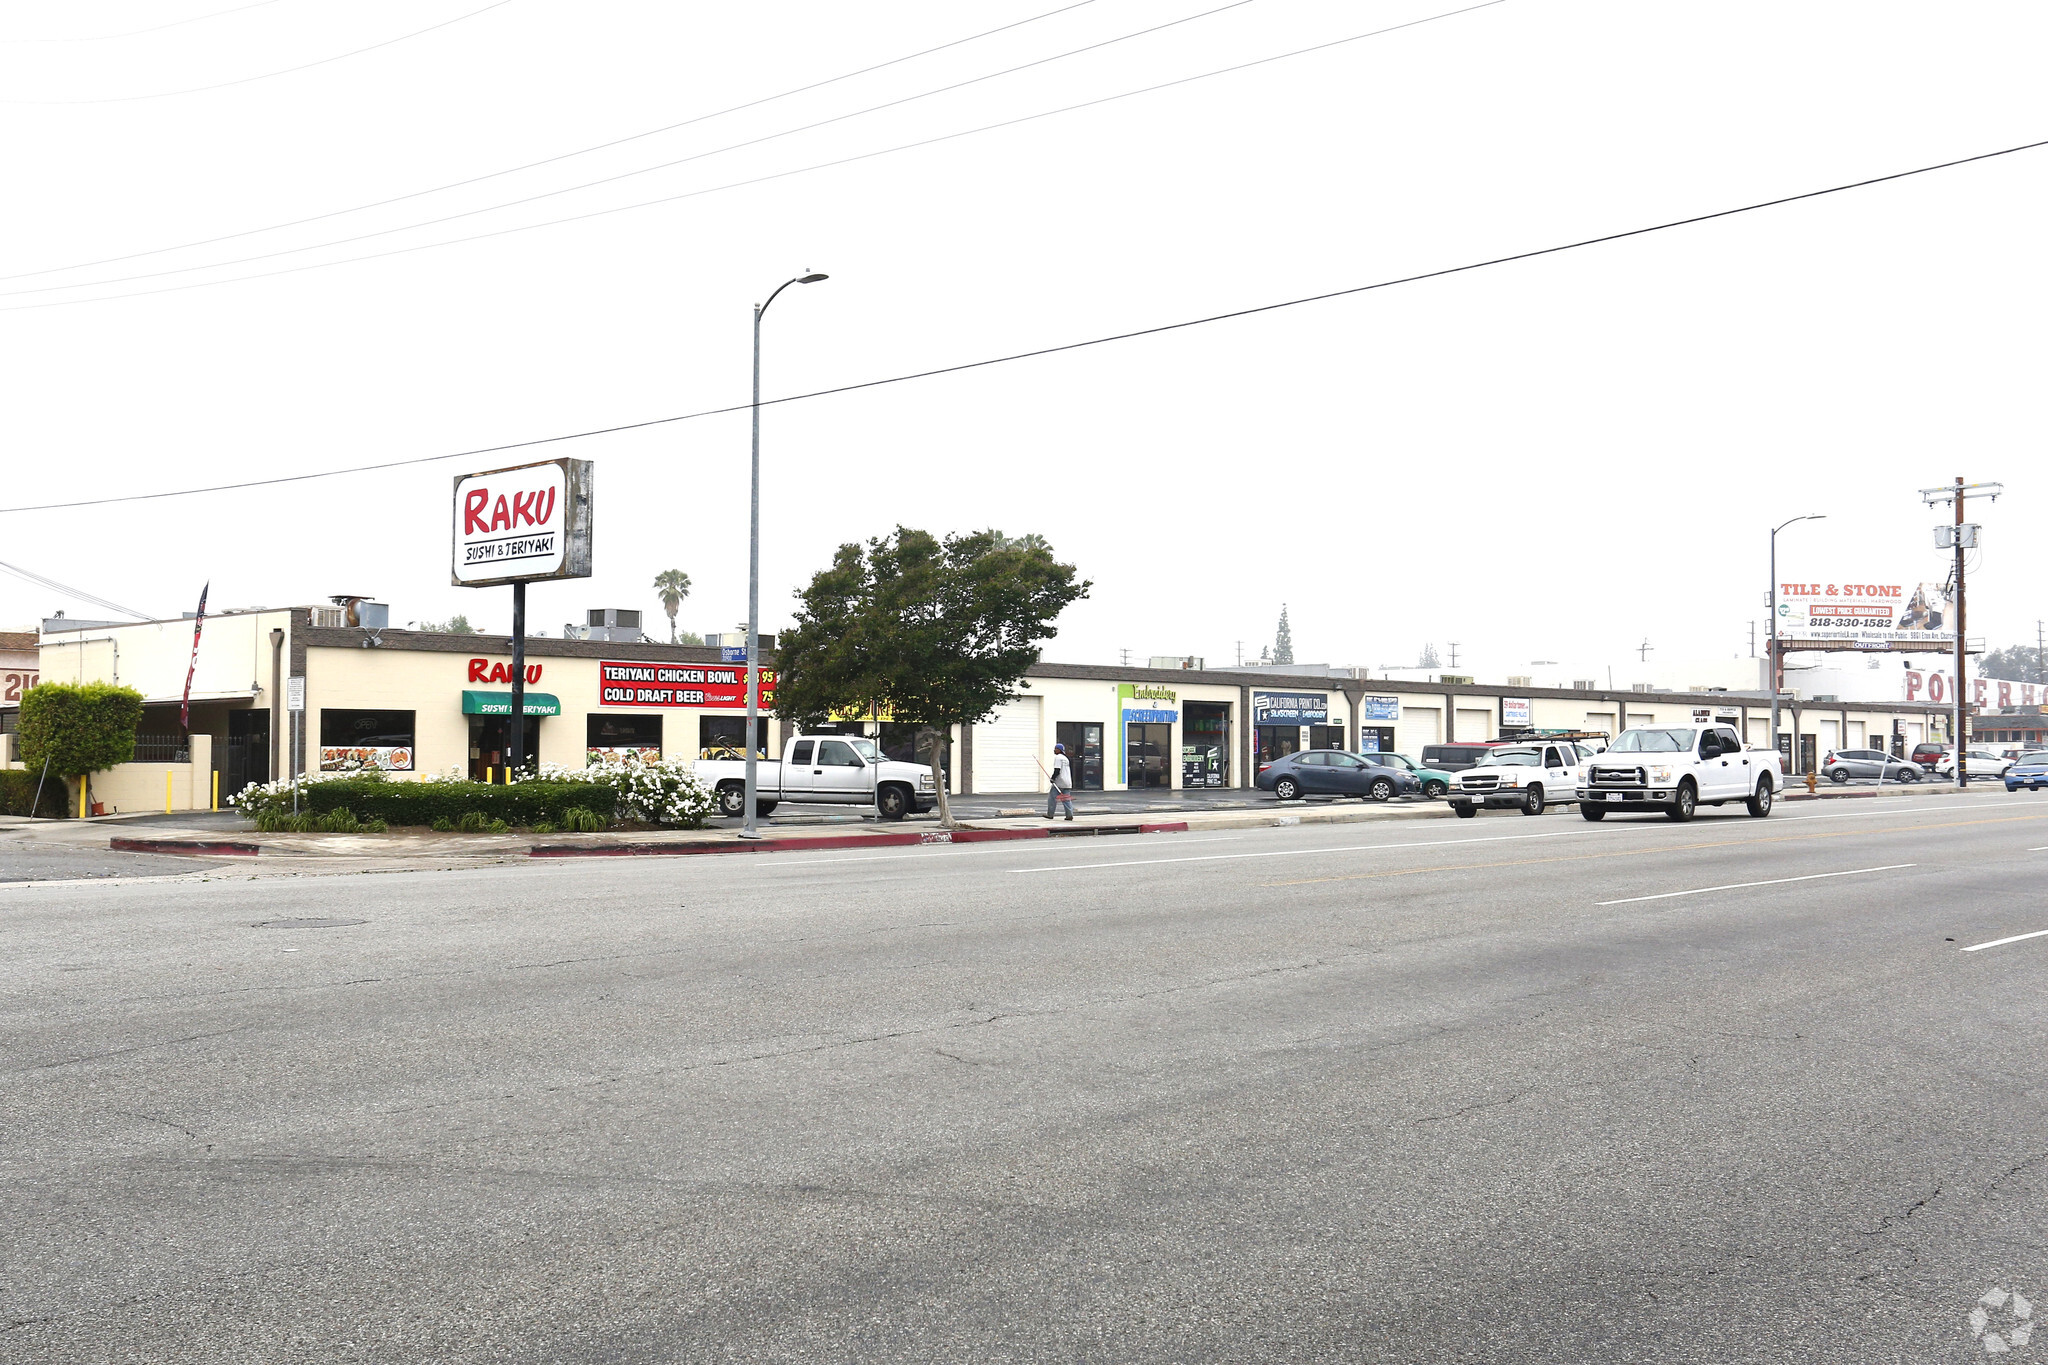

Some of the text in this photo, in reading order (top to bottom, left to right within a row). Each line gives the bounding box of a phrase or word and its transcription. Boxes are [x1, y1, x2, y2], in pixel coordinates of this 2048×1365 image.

[464, 486, 555, 535] RAKU
[466, 537, 554, 560] SUSHI & TERIYAKI
[1780, 584, 1901, 597] TILE & STONE
[1812, 607, 1890, 616] LOWEST PRICE GUARANTEED
[1809, 618, 1892, 628] 818-330-1582
[722, 648, 740, 656] Osborne
[604, 667, 655, 681] TERIYAKI
[657, 669, 705, 683] CHICKEN
[707, 671, 738, 684] BOWL
[762, 671, 774, 683] 95
[604, 688, 634, 701] COLD
[637, 689, 674, 703] DRAFT
[676, 691, 704, 703] BEER
[1133, 684, 1176, 704] Embroidery
[481, 704, 507, 713] SUSHI
[1270, 697, 1298, 709] CALIFORNIA
[1299, 698, 1312, 709] PRINT
